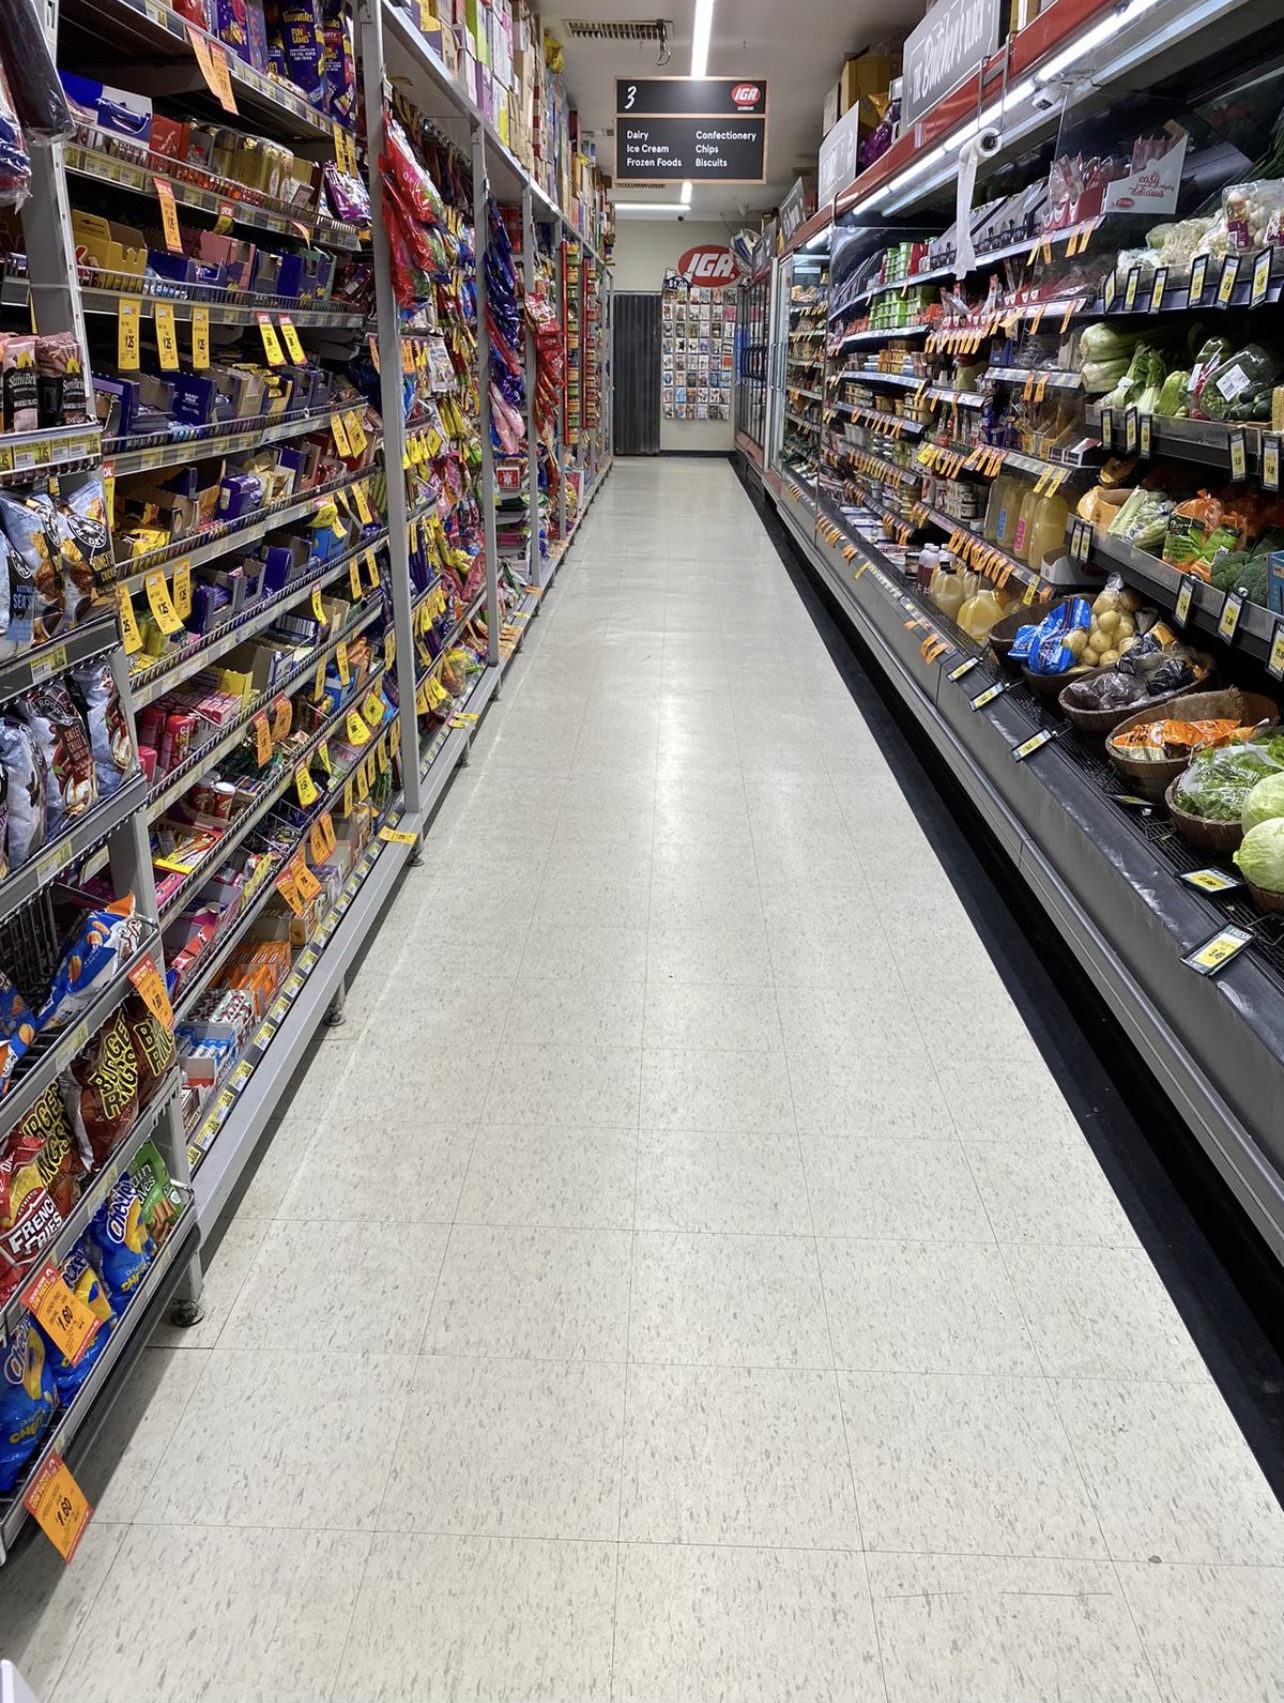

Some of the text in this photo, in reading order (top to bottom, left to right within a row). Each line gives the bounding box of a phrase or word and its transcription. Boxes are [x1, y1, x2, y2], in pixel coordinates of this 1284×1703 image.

[624, 85, 637, 109] 3
[734, 88, 758, 101] IGA
[626, 131, 649, 141] Dairy
[695, 131, 757, 142] Confectionery
[626, 145, 670, 153] Ice Cream
[695, 145, 719, 155] Chips
[626, 158, 682, 167] Frozen Foods
[695, 158, 728, 167] Biscuits
[686, 253, 735, 277] IGA
[17, 1188, 39, 1216] AUTHENTIC
[8, 1199, 55, 1255] FRENC
[24, 1212, 62, 1256] FRIES
